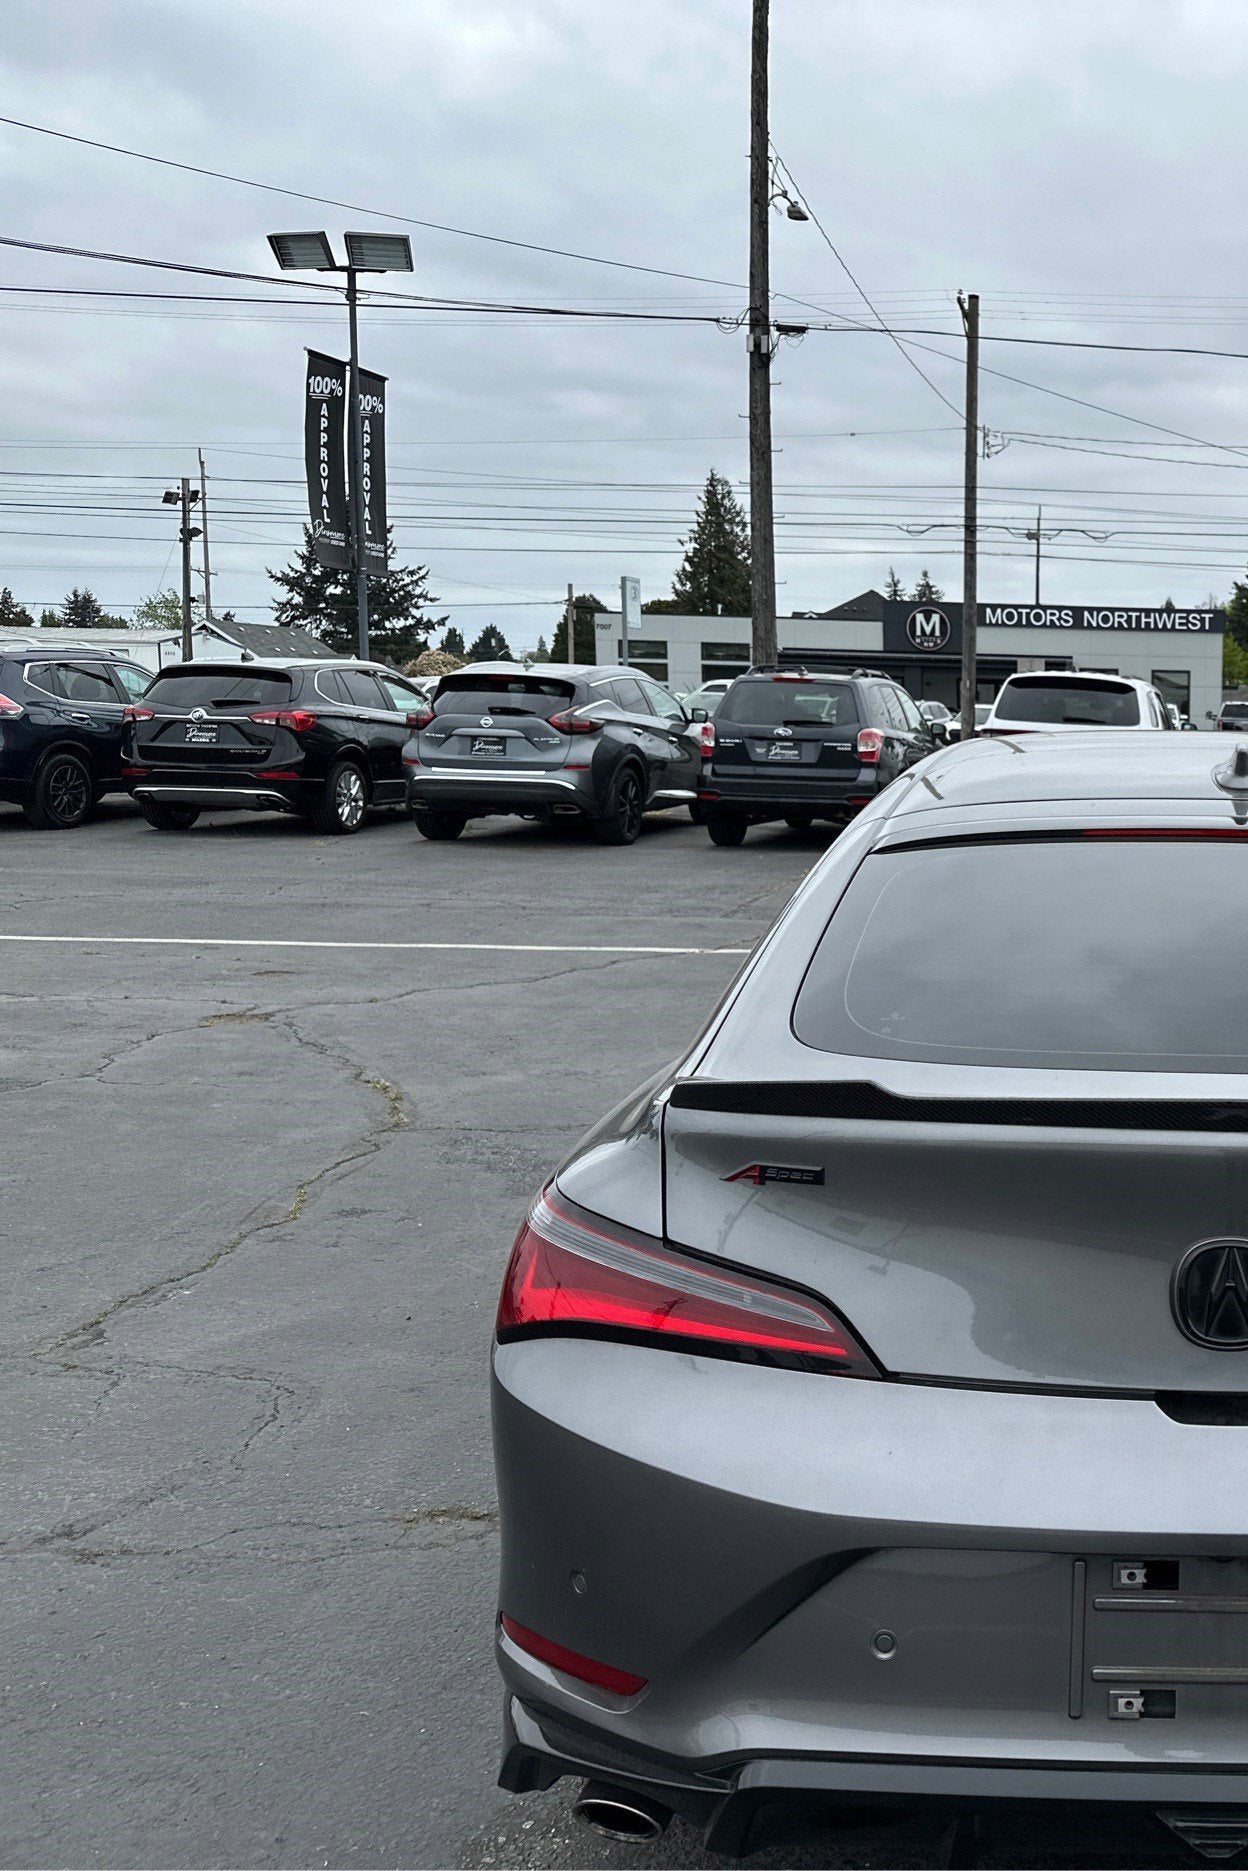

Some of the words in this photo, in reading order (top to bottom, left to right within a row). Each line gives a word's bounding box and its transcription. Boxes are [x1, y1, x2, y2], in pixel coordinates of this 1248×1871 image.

[308, 375, 343, 396] 100%
[319, 402, 331, 523] APPROVAL
[362, 419, 372, 535] APPROVAL
[915, 612, 941, 637] M
[985, 607, 1074, 627] MOTORS
[1083, 610, 1214, 631] NORTHWEST
